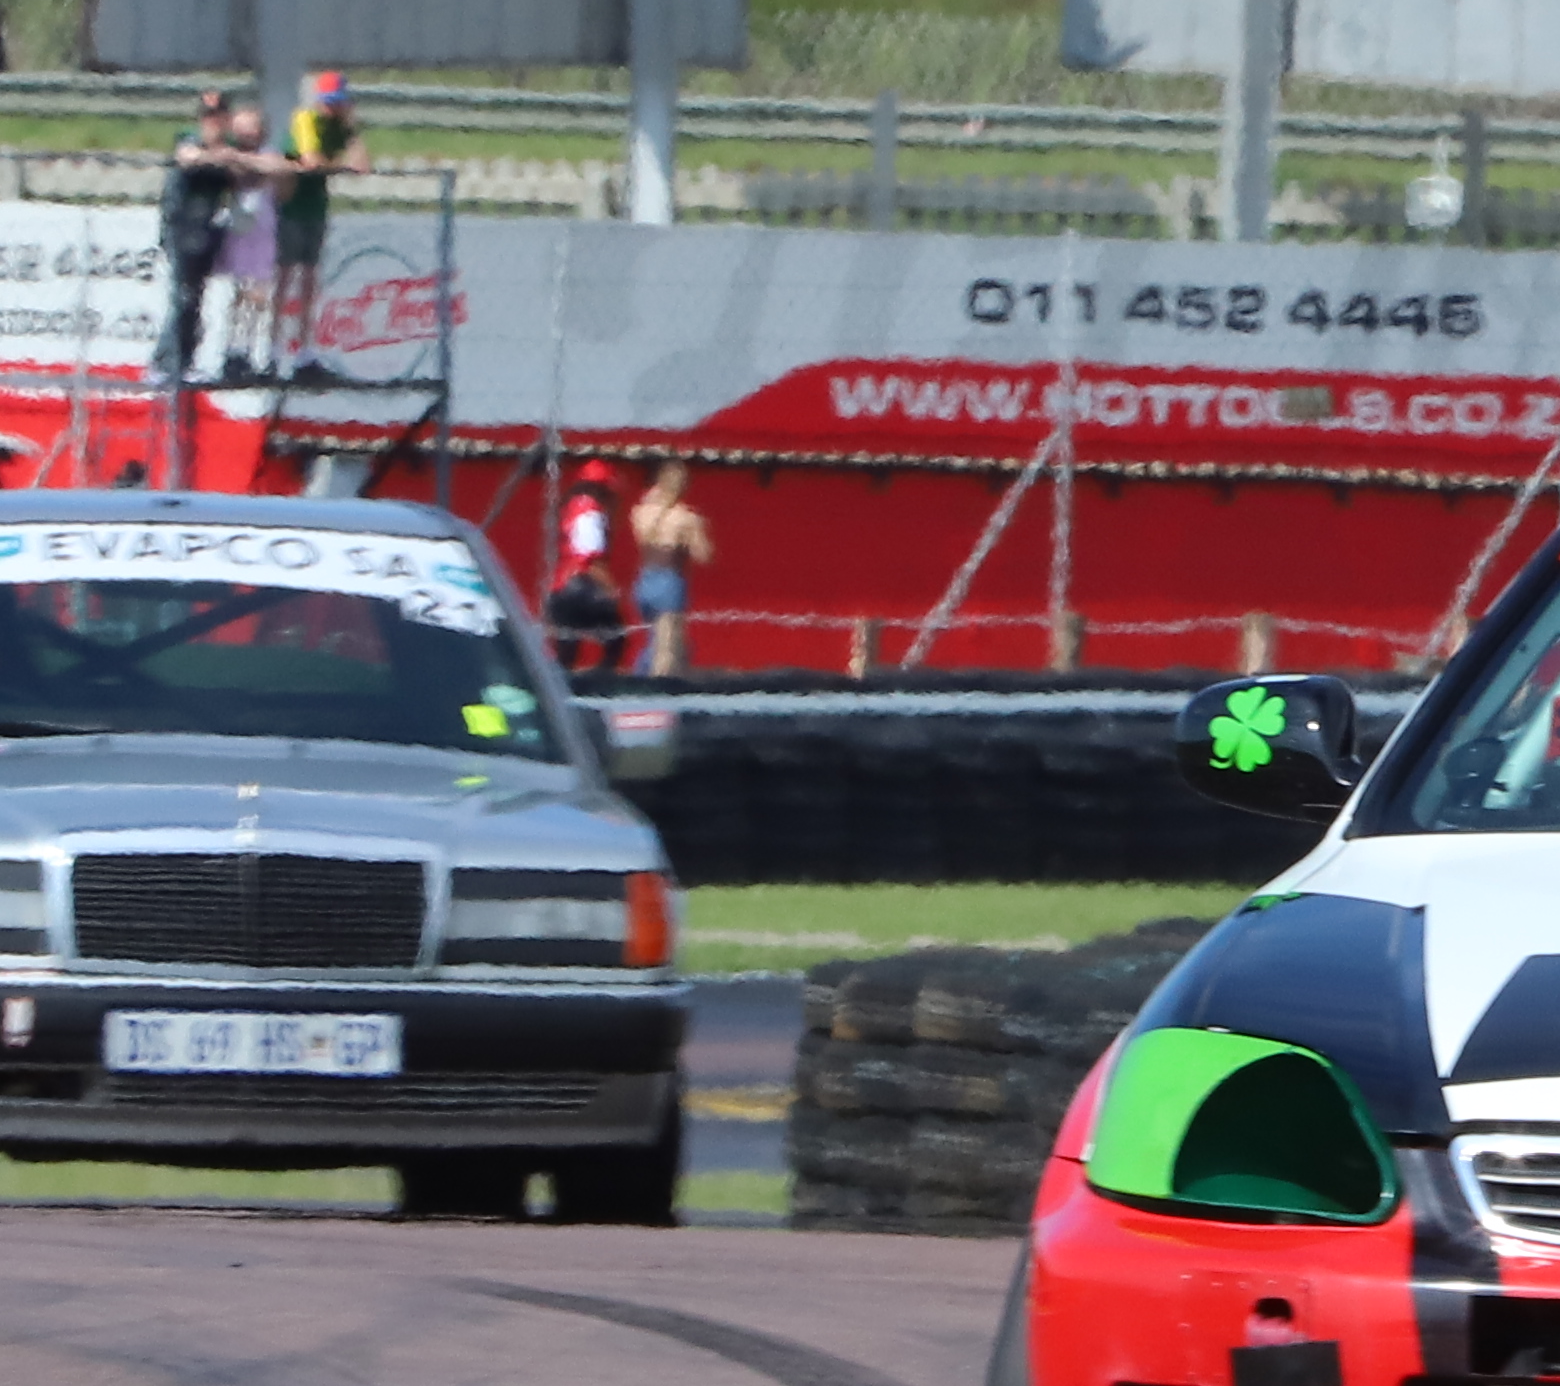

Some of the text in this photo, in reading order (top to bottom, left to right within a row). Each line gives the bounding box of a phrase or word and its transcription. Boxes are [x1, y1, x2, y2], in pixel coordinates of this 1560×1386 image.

[963, 277, 1483, 338] 011 452 4445
[42, 530, 420, 581] EVAPCO SA
